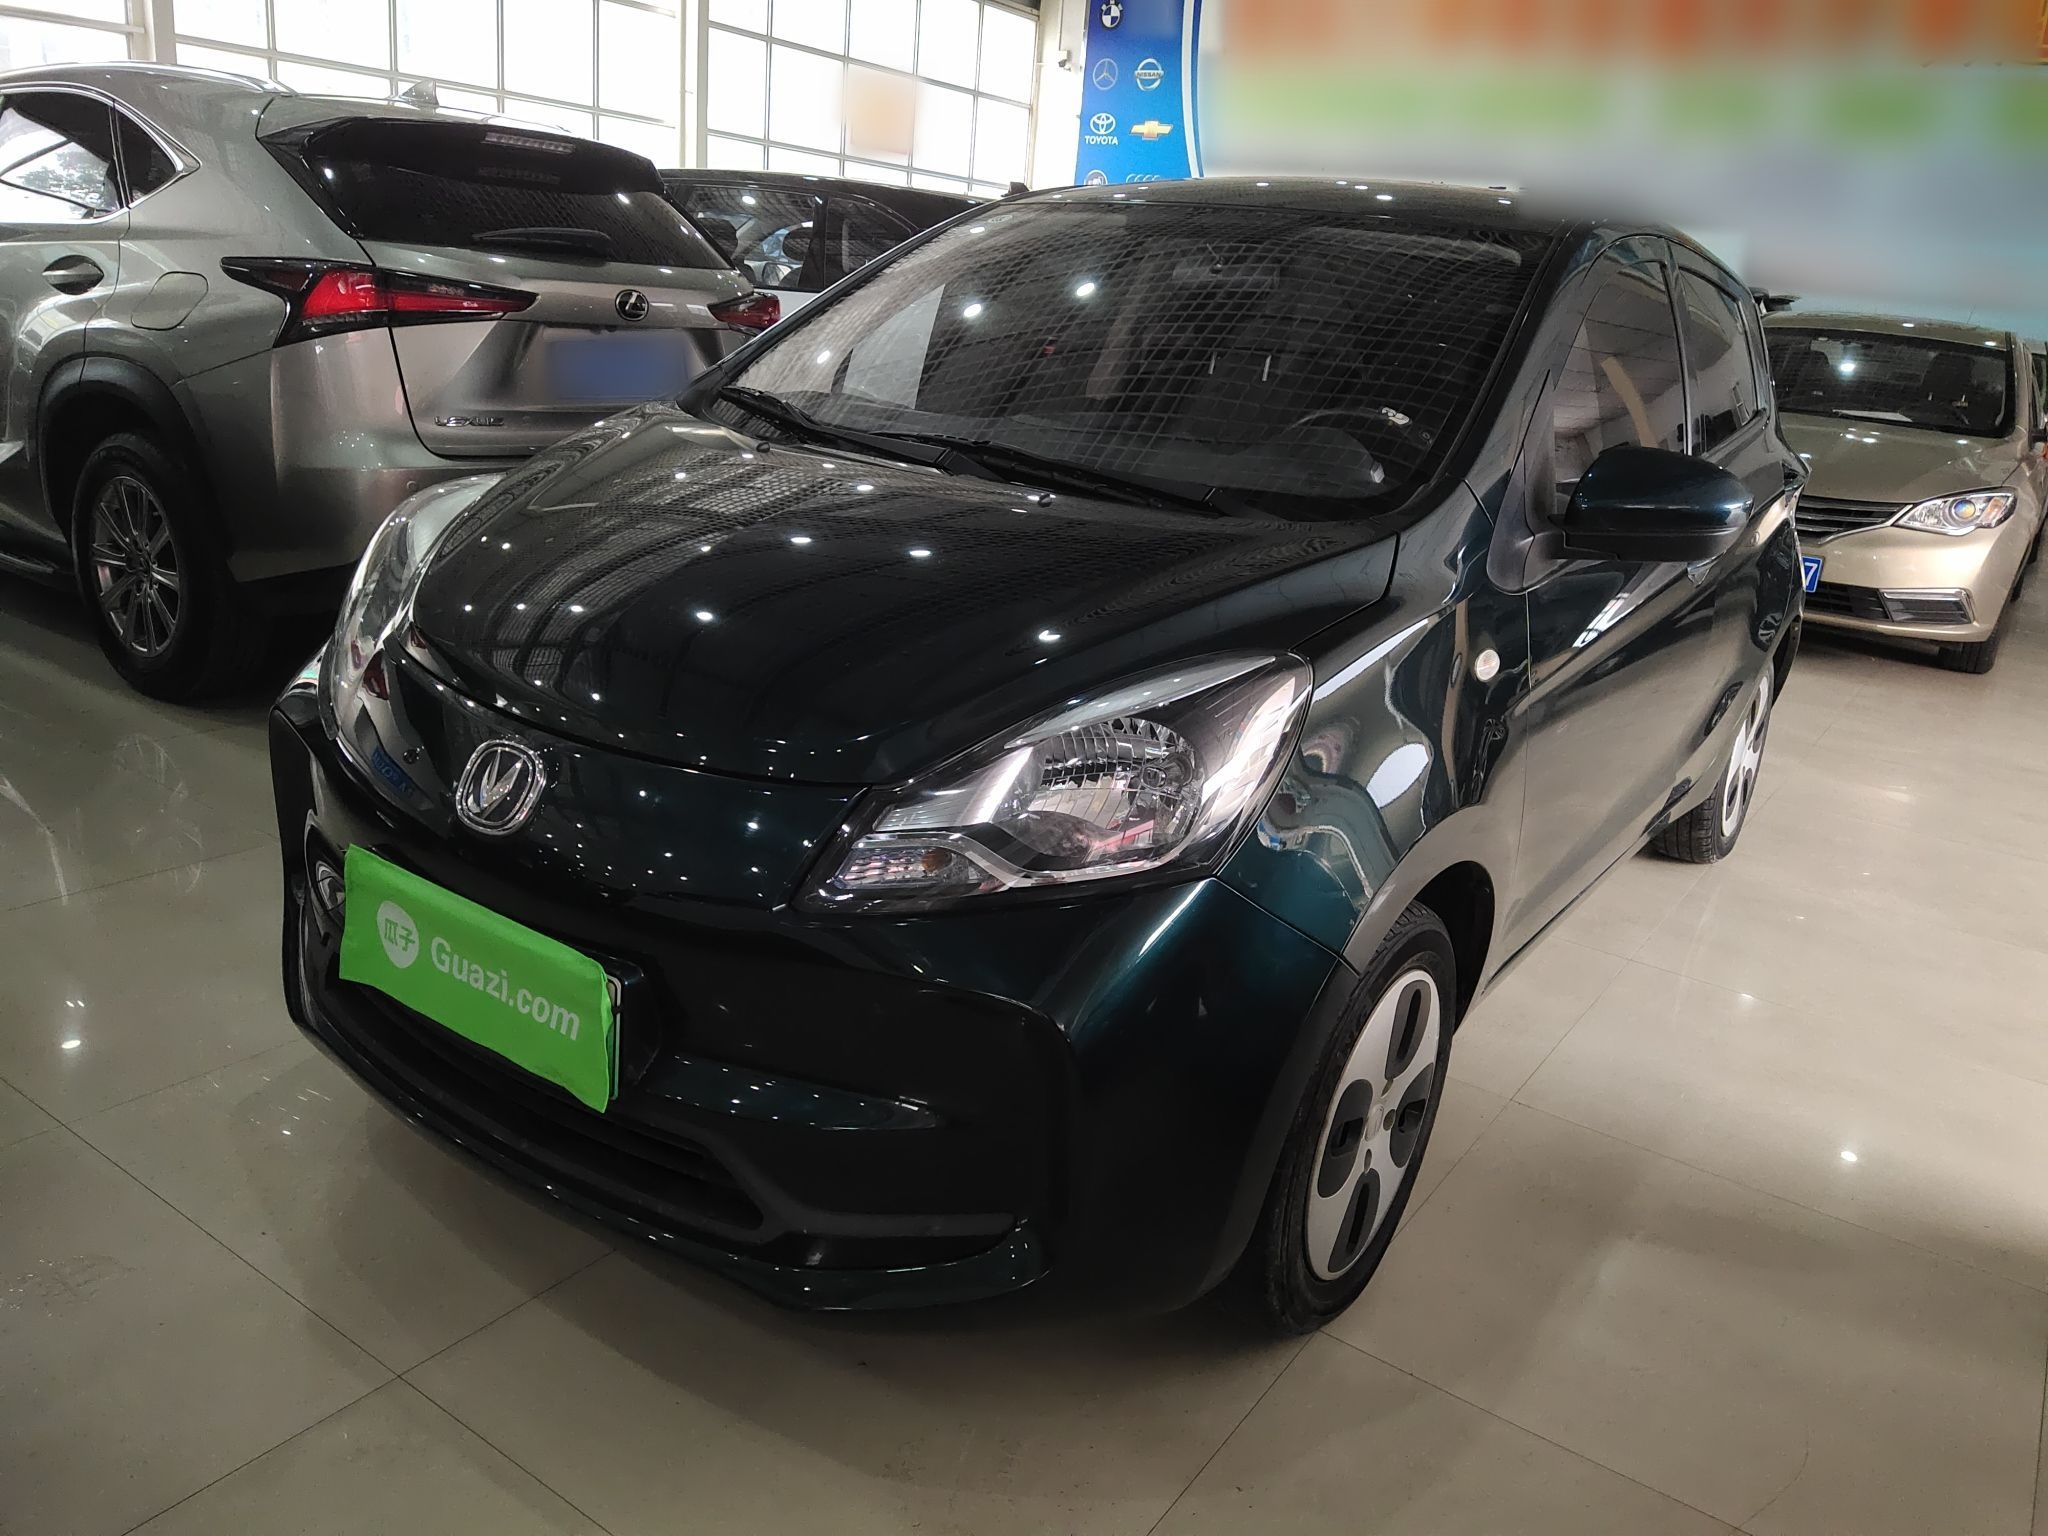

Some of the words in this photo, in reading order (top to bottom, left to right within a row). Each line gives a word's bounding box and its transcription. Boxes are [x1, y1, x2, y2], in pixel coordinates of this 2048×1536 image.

[1085, 135, 1118, 145] TOYOTA
[384, 918, 416, 952] 瓜子
[430, 936, 580, 1041] Guazi.com
